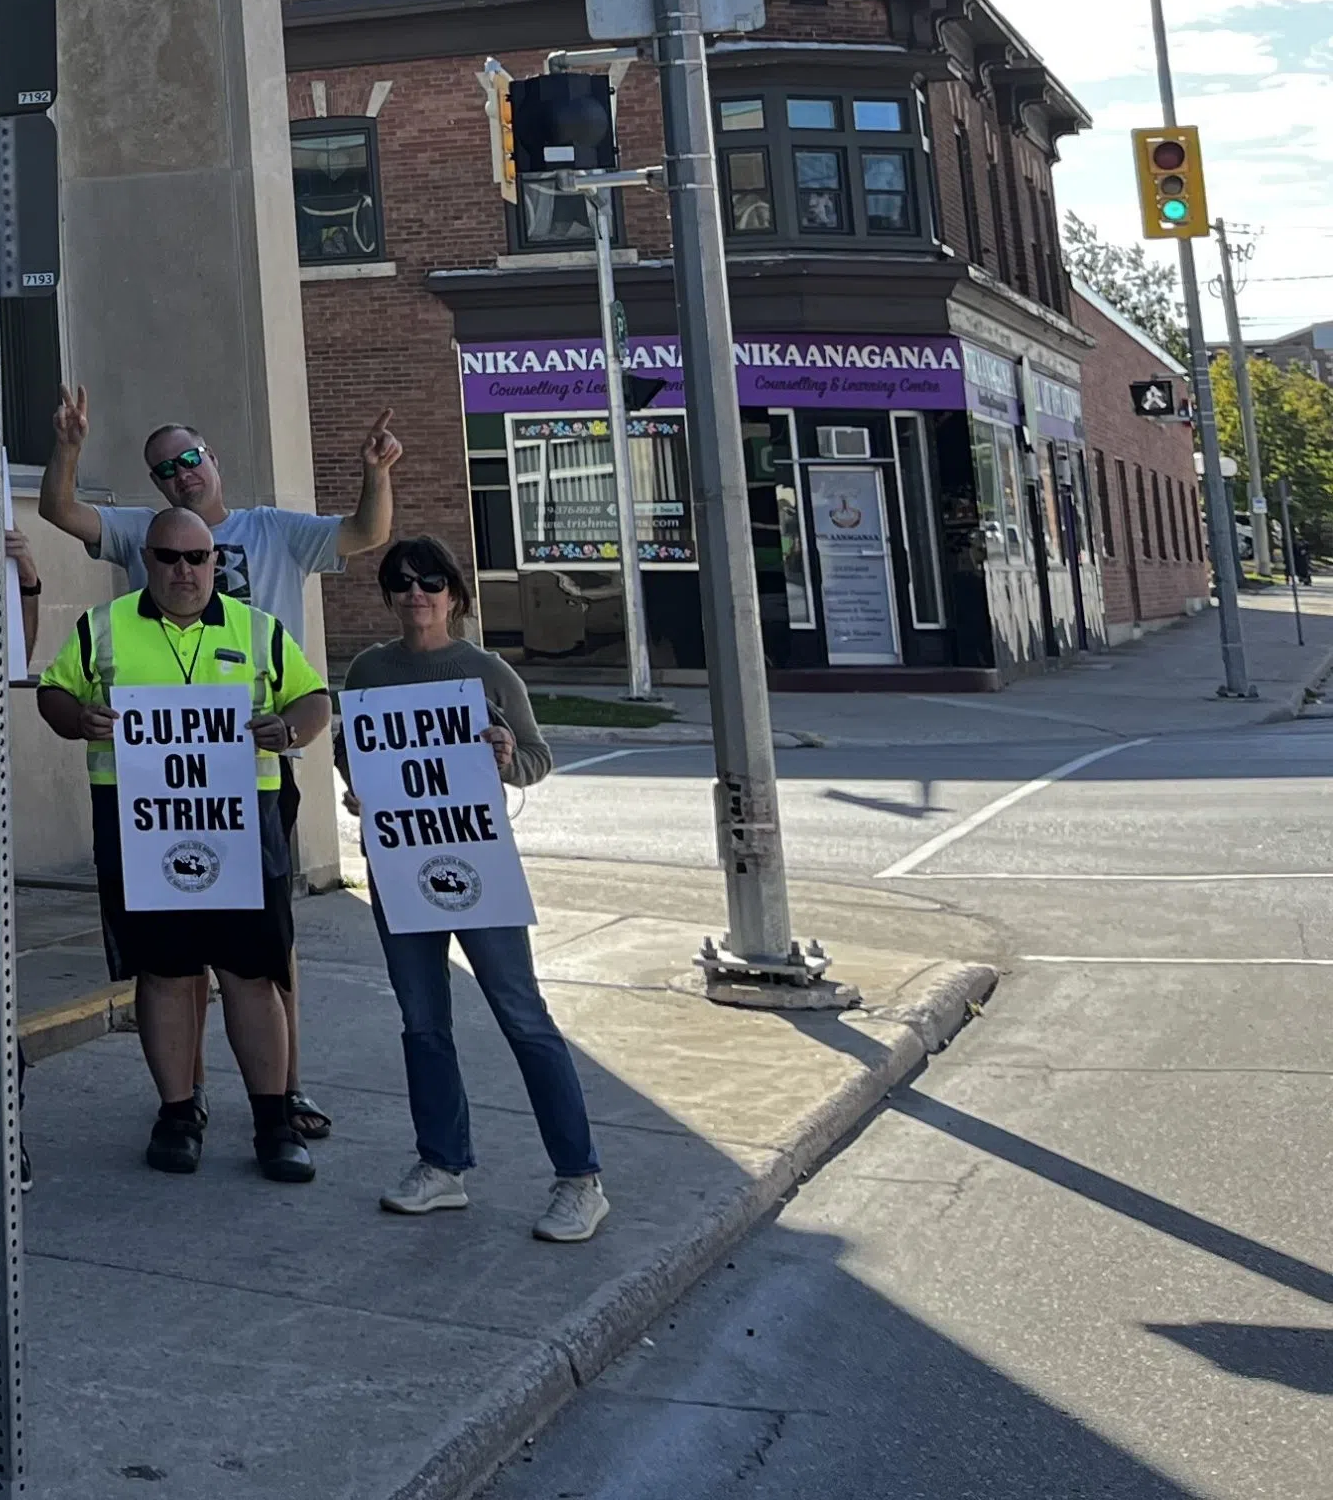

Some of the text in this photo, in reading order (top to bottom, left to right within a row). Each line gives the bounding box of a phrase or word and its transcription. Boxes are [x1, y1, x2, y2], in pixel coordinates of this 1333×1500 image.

[21, 92, 48, 102] 7192
[25, 275, 52, 284] 7193
[732, 343, 961, 370] NIKAANAGANAA
[489, 380, 570, 401] Counselling
[755, 375, 827, 398] Counselling
[123, 708, 243, 745] C.U.P.W.
[353, 705, 481, 753] C.U.P.W.
[165, 754, 207, 789] ON
[401, 758, 449, 798] ON
[133, 797, 245, 831] STRIKE
[374, 804, 498, 849] STRIKE
